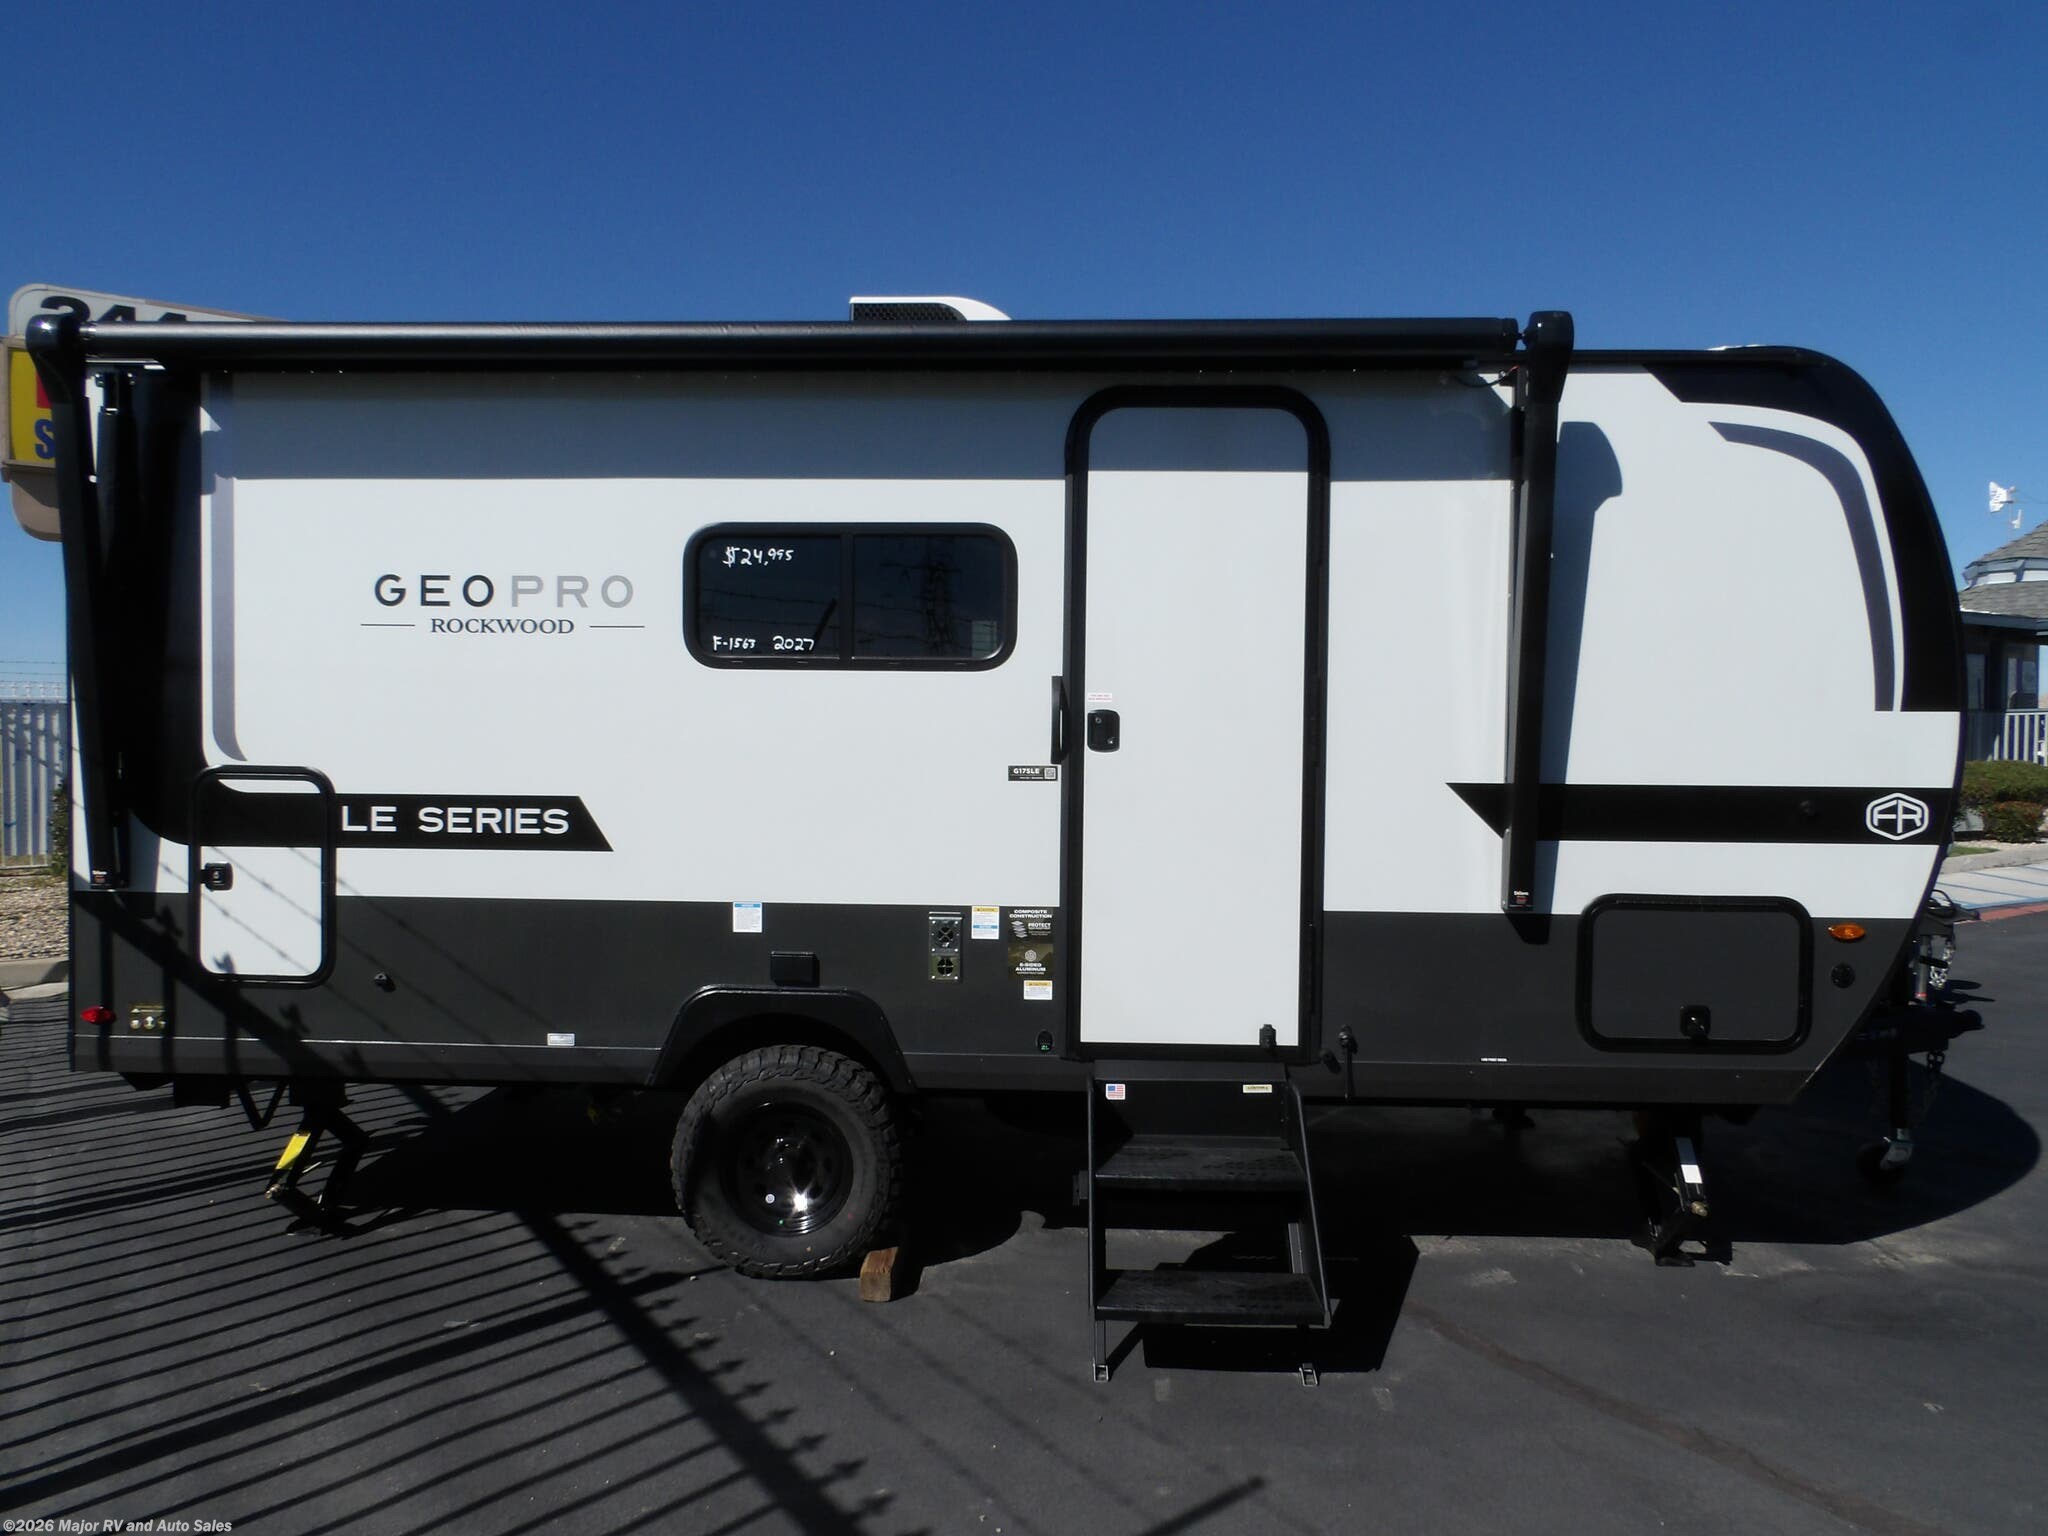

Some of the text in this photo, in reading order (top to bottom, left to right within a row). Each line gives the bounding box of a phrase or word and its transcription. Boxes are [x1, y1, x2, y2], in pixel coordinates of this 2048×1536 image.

[722, 546, 795, 568] $24,995
[431, 618, 575, 635] ROCKWOOD
[772, 635, 815, 651] 2027
[341, 805, 570, 835] LE SERIES
